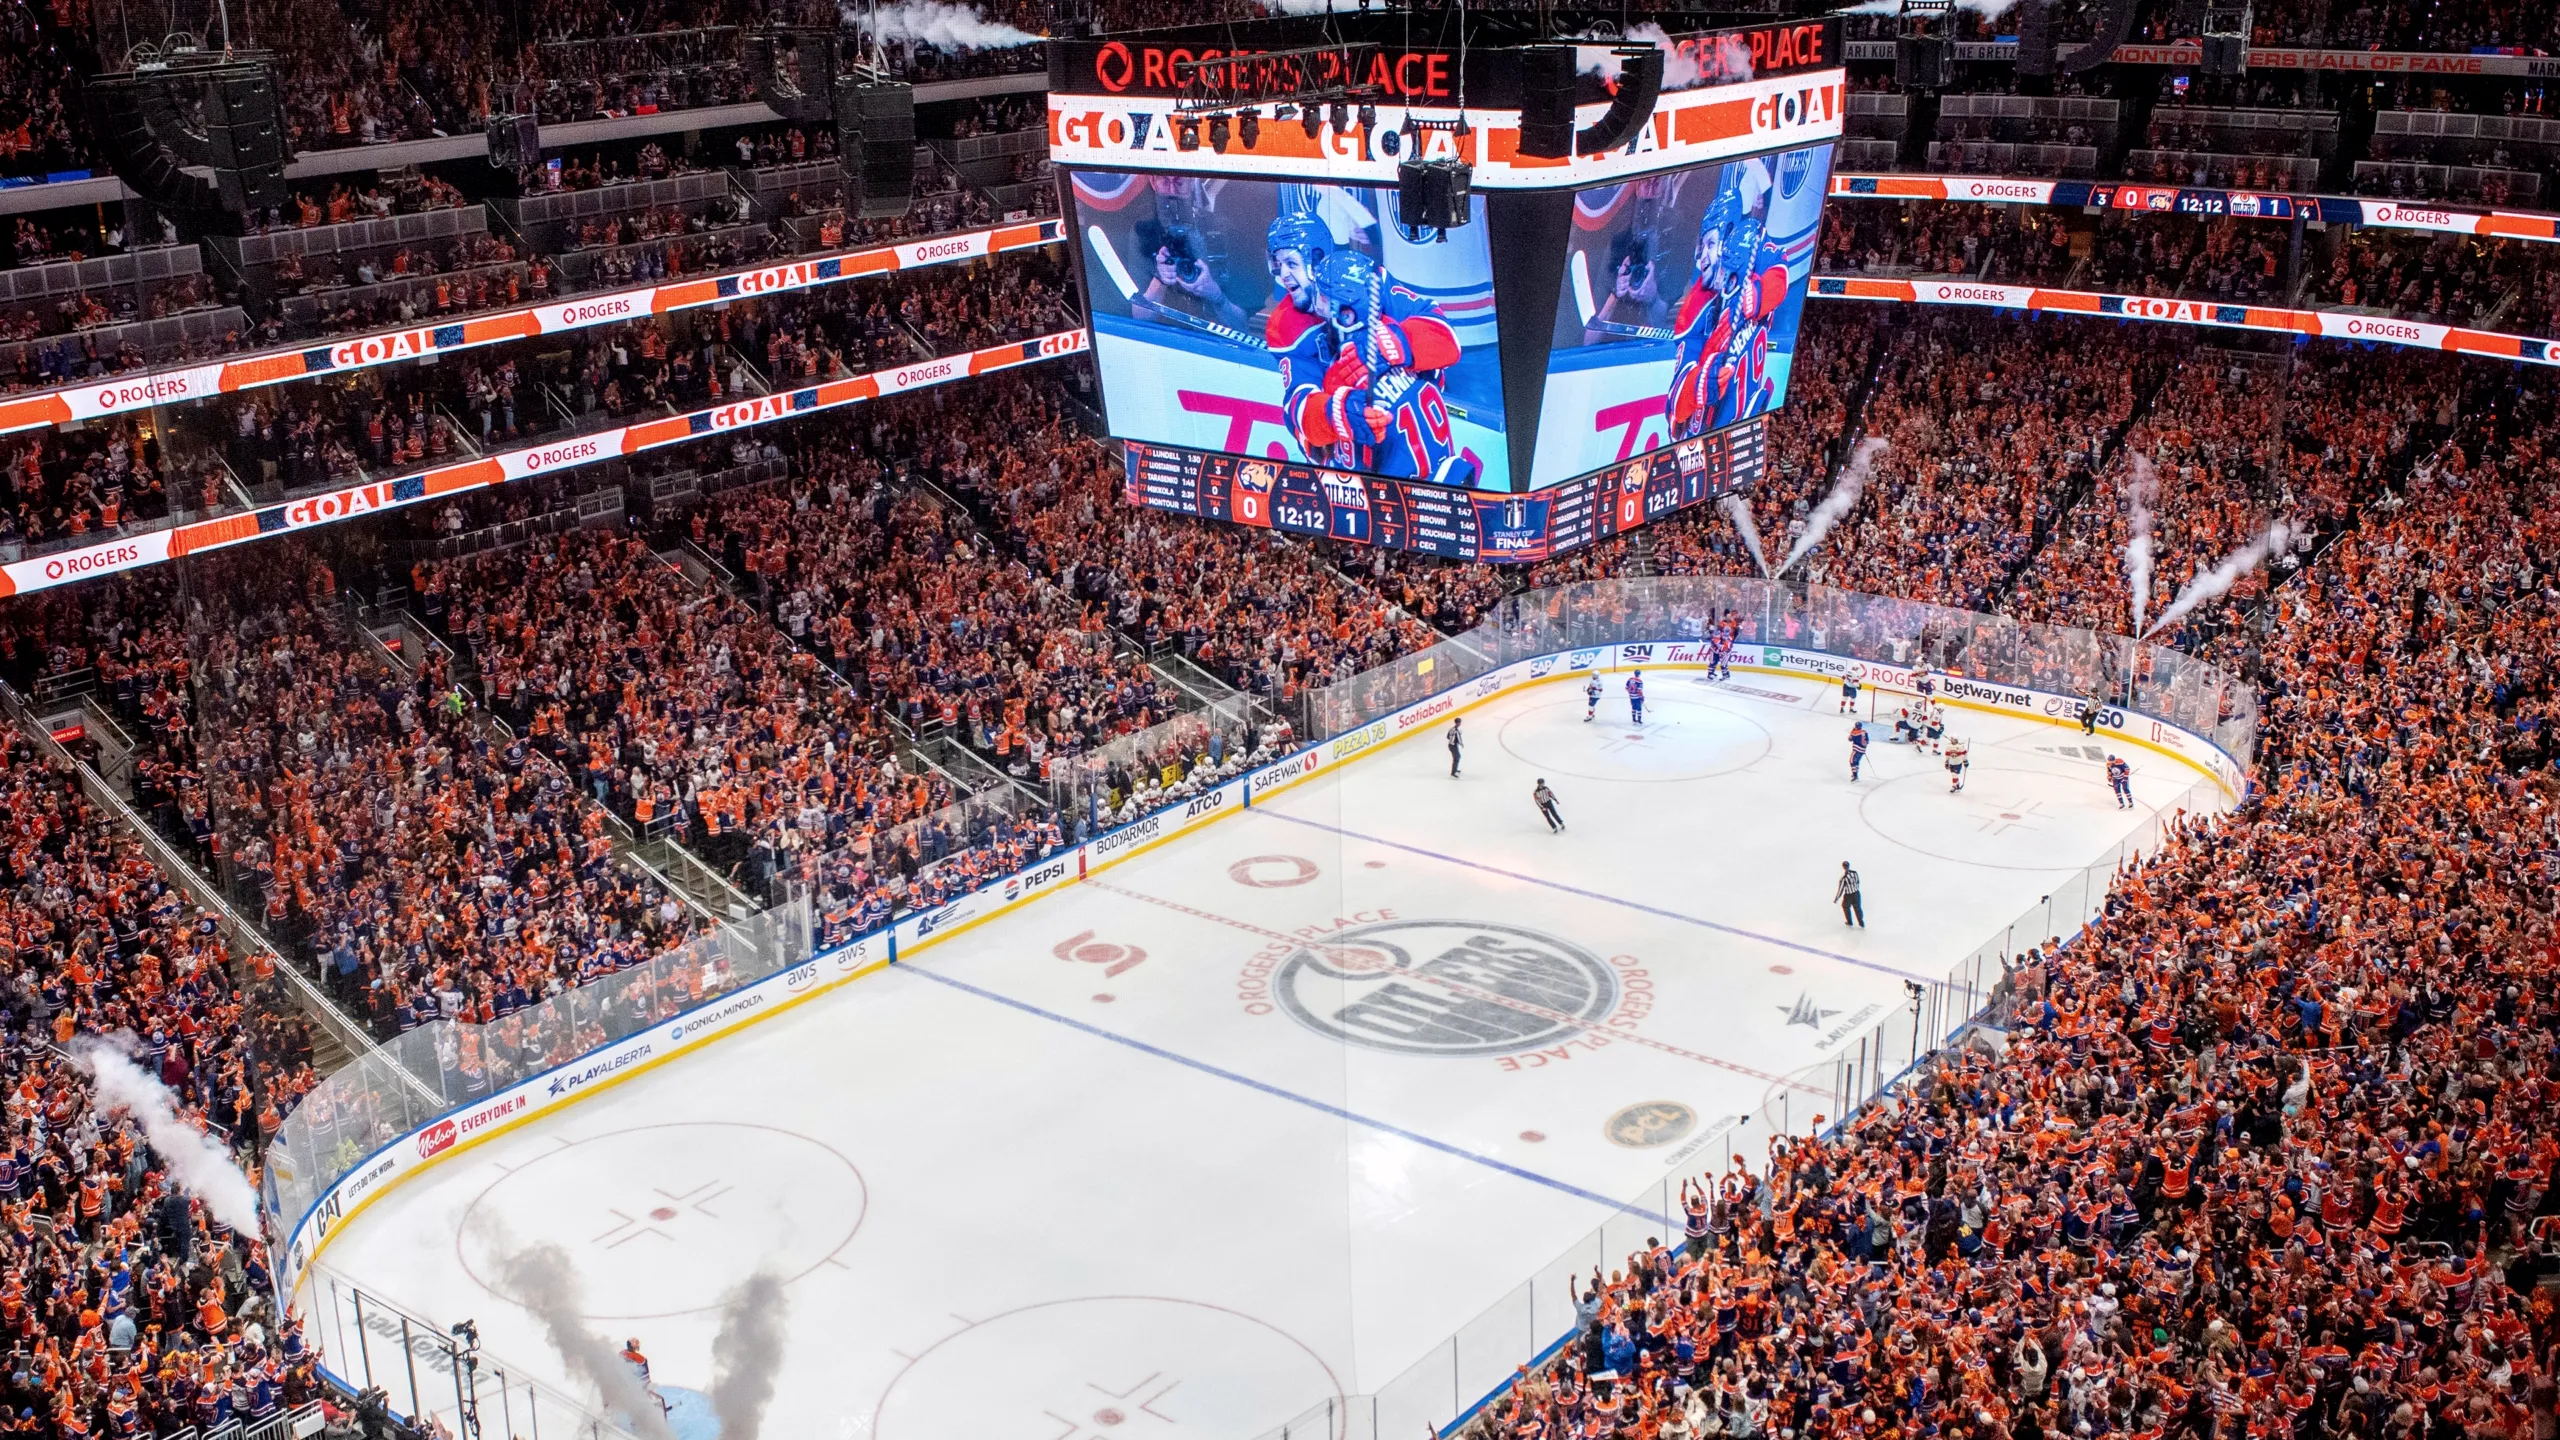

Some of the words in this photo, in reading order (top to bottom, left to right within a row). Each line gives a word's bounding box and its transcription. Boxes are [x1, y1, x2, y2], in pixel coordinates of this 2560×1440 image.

[1752, 24, 1824, 71] PLACE
[2302, 54, 2365, 69] HALL
[2371, 56, 2404, 70] OF
[2409, 57, 2482, 73] FAME
[1987, 184, 2037, 198] ROGERS
[2098, 194, 2106, 205] 3
[2126, 190, 2136, 206] 0
[2181, 198, 2223, 214] 12:12
[2270, 200, 2279, 215] 1
[2300, 206, 2309, 219] 4
[2395, 209, 2451, 226] ROGERS
[929, 240, 970, 258] ROGERS
[737, 262, 818, 297] GOAL
[1954, 286, 2005, 302] ROGERS
[579, 299, 631, 321] ROGERS
[2122, 298, 2217, 325] GOAL
[2365, 322, 2420, 341] ROGERS
[330, 328, 439, 370] GOAL
[910, 362, 952, 383] ROGERS
[1734, 326, 1768, 421] 19
[120, 378, 188, 404] ROGERS
[711, 396, 798, 434] GOAL
[1397, 381, 1450, 480] 19
[544, 441, 598, 466] ROGERS
[1153, 449, 1181, 461] LUNDELL
[1187, 454, 1202, 464] 1:30
[1183, 466, 1198, 475] 1:12
[1215, 466, 1221, 475] 3
[1652, 467, 1657, 476] 3
[1670, 461, 1676, 470] 4
[1714, 463, 1719, 472] 4
[1147, 473, 1179, 485] TARASENKO
[1282, 478, 1289, 488] 3
[1310, 482, 1317, 492] 4
[1606, 480, 1612, 489] 3
[1690, 476, 1697, 498] 1
[1147, 486, 1175, 496] MIKKOLA
[1181, 490, 1195, 499] 2:39
[1211, 486, 1218, 495] 0
[1325, 482, 1367, 510] OILERS
[1379, 490, 1386, 499] 5
[1403, 486, 1411, 494] 19
[1411, 487, 1448, 500] HENRIQUE
[1647, 487, 1678, 514] 12:12
[284, 481, 398, 531] GOAL
[1148, 497, 1180, 509] MONTOUR
[1183, 502, 1197, 511] 3:04
[1212, 507, 1219, 515] 0
[1243, 496, 1257, 519] 0
[1416, 501, 1452, 514] JANMARK
[1457, 507, 1472, 516] 1:47
[1603, 503, 1609, 512] 0
[1624, 499, 1635, 522] 0
[1277, 506, 1325, 530] 12:12
[1345, 512, 1356, 535] 1
[1385, 513, 1392, 522] 4
[1419, 514, 1447, 526] BROWN
[1460, 521, 1475, 530] 1:40
[1384, 534, 1391, 543] 3
[1420, 527, 1456, 540] BOUCHARD
[1460, 534, 1476, 544] 3:53
[1493, 530, 1522, 538] STANLEY
[1602, 524, 1608, 534] 0
[1419, 541, 1437, 551] CECI
[1459, 547, 1475, 557] 2:03
[1496, 537, 1532, 549] FINAL
[67, 545, 139, 573] ROGERS
[1571, 652, 1594, 667] SAP
[1622, 644, 1654, 658] SN
[1667, 644, 1698, 662] Tim
[1768, 651, 1846, 672] enterprise
[1530, 658, 1551, 677] SAP
[1476, 674, 1502, 697] Ford
[1871, 667, 1937, 691] ROGES
[1944, 678, 2032, 707] betway.net
[1397, 695, 1454, 729] Scotiabank
[1912, 711, 1923, 723] 72
[1333, 729, 1370, 759] PIZZA
[1371, 722, 1387, 740] 73
[1254, 759, 1303, 792] SAFEWAY
[1186, 790, 1222, 819] ATCO
[1096, 816, 1159, 855] BODYARMOR
[1025, 861, 1065, 890] PEPSI
[1294, 907, 1401, 940] PLACE
[837, 943, 867, 965] aws
[786, 963, 818, 987] aws
[1237, 942, 1293, 1001] ROGERS
[1332, 934, 1547, 1037] OILERS
[1612, 966, 1655, 1030] ROGERS
[684, 1011, 723, 1035] KONICA
[723, 994, 764, 1019] MINOLTA
[1814, 1003, 1884, 1050] PLAYALBERTA
[1494, 1029, 1612, 1072] PLACE
[568, 1044, 652, 1089] PLAYALBERTA
[461, 1100, 514, 1134] EVERYONE
[515, 1094, 527, 1109] IN
[416, 1123, 458, 1157] Molson
[347, 1181, 362, 1199] LET'S
[360, 1175, 369, 1187] DO
[368, 1166, 380, 1183] THE
[316, 1188, 342, 1238] CAT
